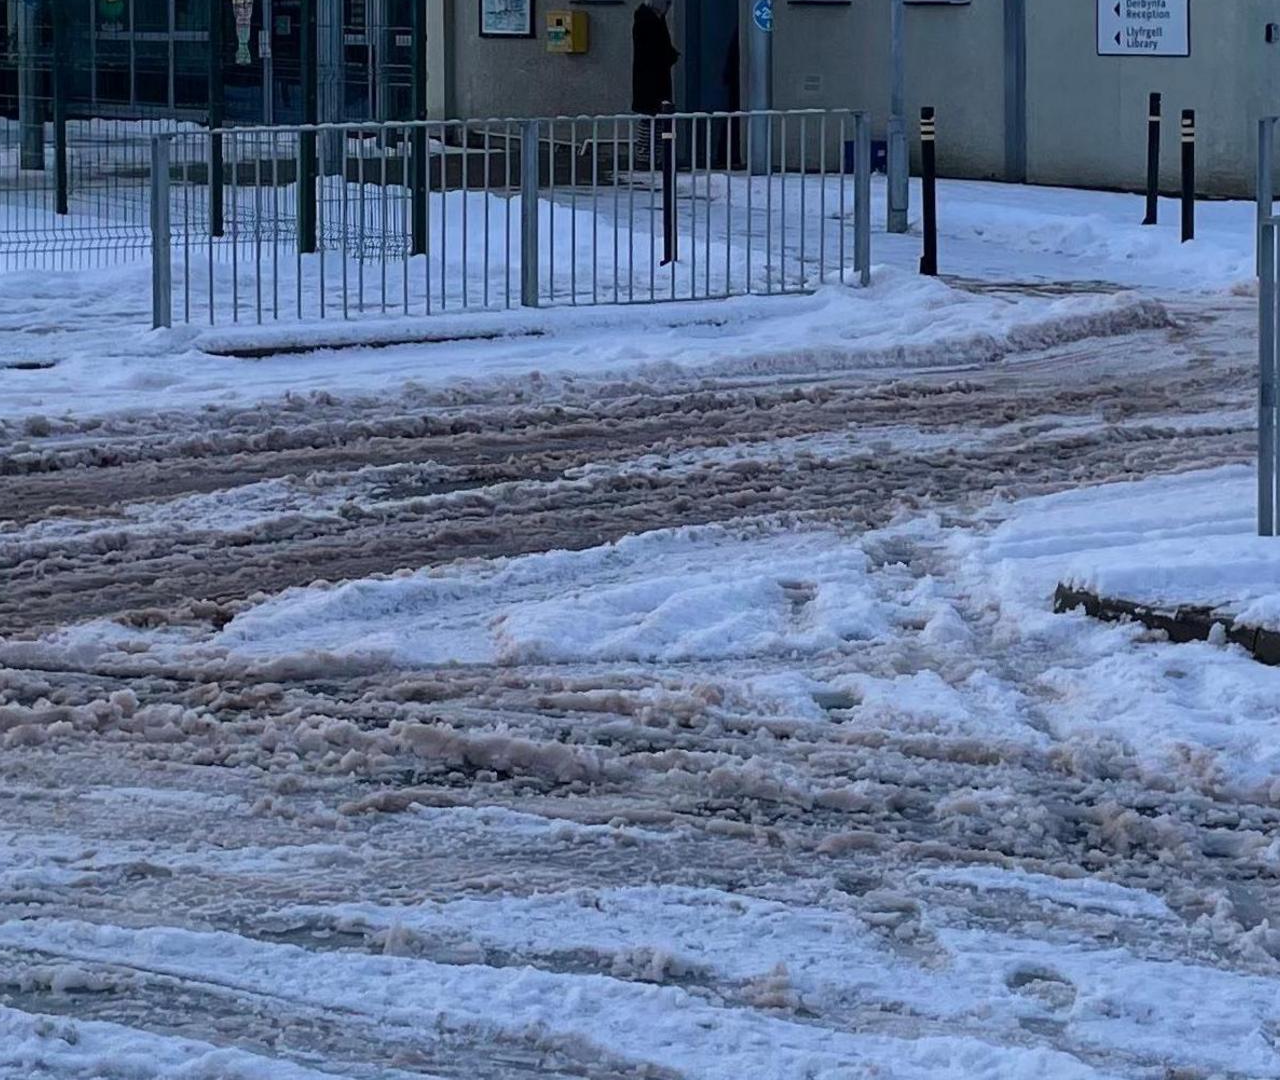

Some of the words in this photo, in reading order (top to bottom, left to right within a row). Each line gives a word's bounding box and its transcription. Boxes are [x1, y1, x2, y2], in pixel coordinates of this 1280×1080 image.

[1126, 10, 1170, 21] Reception
[1126, 27, 1162, 39] Llyfrgell
[1126, 39, 1158, 50] Library
